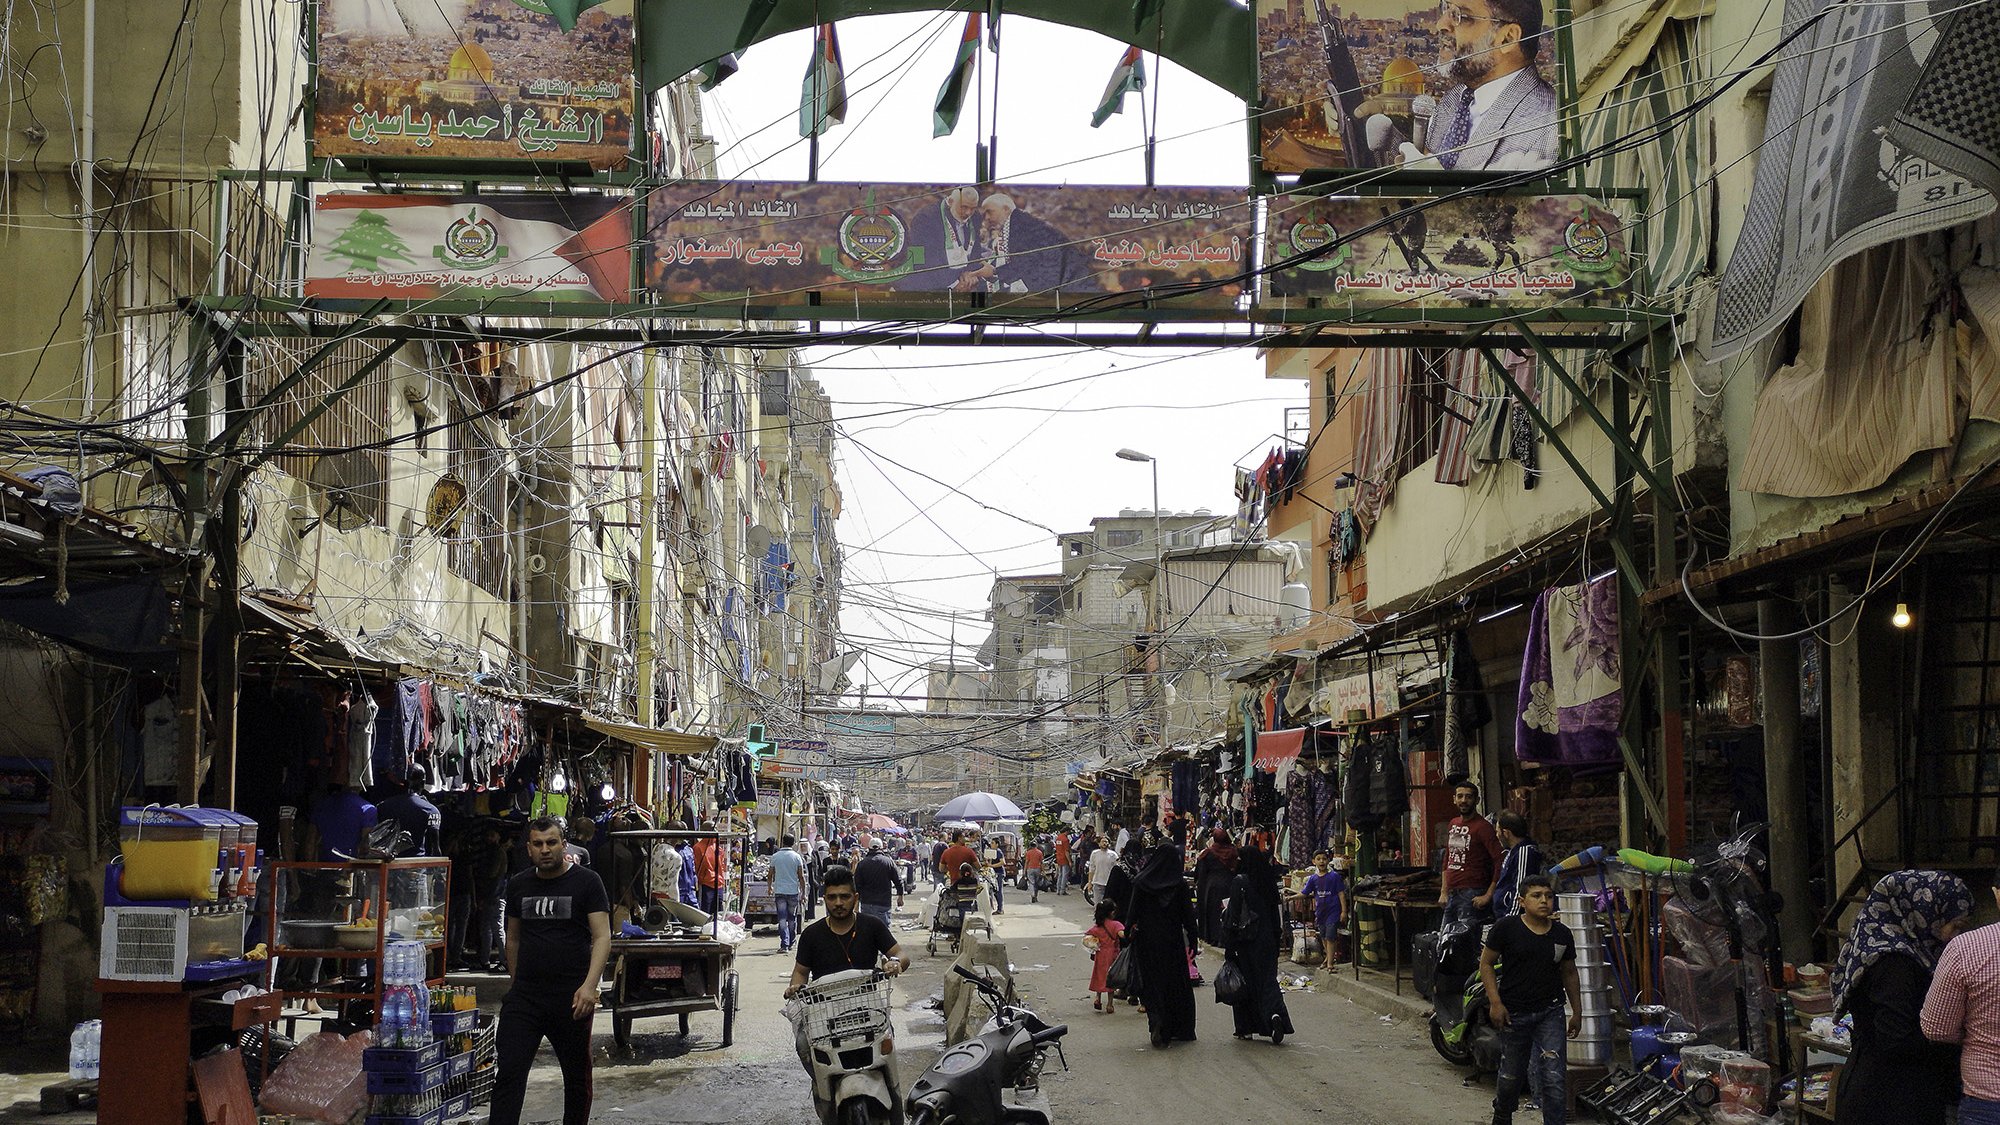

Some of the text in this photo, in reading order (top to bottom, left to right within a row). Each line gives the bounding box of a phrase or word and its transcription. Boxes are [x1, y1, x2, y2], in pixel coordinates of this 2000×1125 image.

[529, 78, 620, 101] الشهيد القائد
[347, 102, 605, 153] الشيخ أحمد ياسين
[683, 200, 798, 222] القائد المجاهد
[1107, 201, 1221, 224] القائد المجاهد
[659, 236, 804, 266] يحيى السنوار
[1092, 235, 1241, 269] أسماعيل هنية
[458, 274, 481, 286] وجه
[484, 273, 499, 290] في
[501, 274, 533, 287] لبنان
[545, 271, 590, 287] فلسطين
[1335, 271, 1576, 296] فلتحيا كتائب عز الدين القسام
[457, 1015, 473, 1029] PEPSI
[448, 1100, 463, 1115] PEPSI
